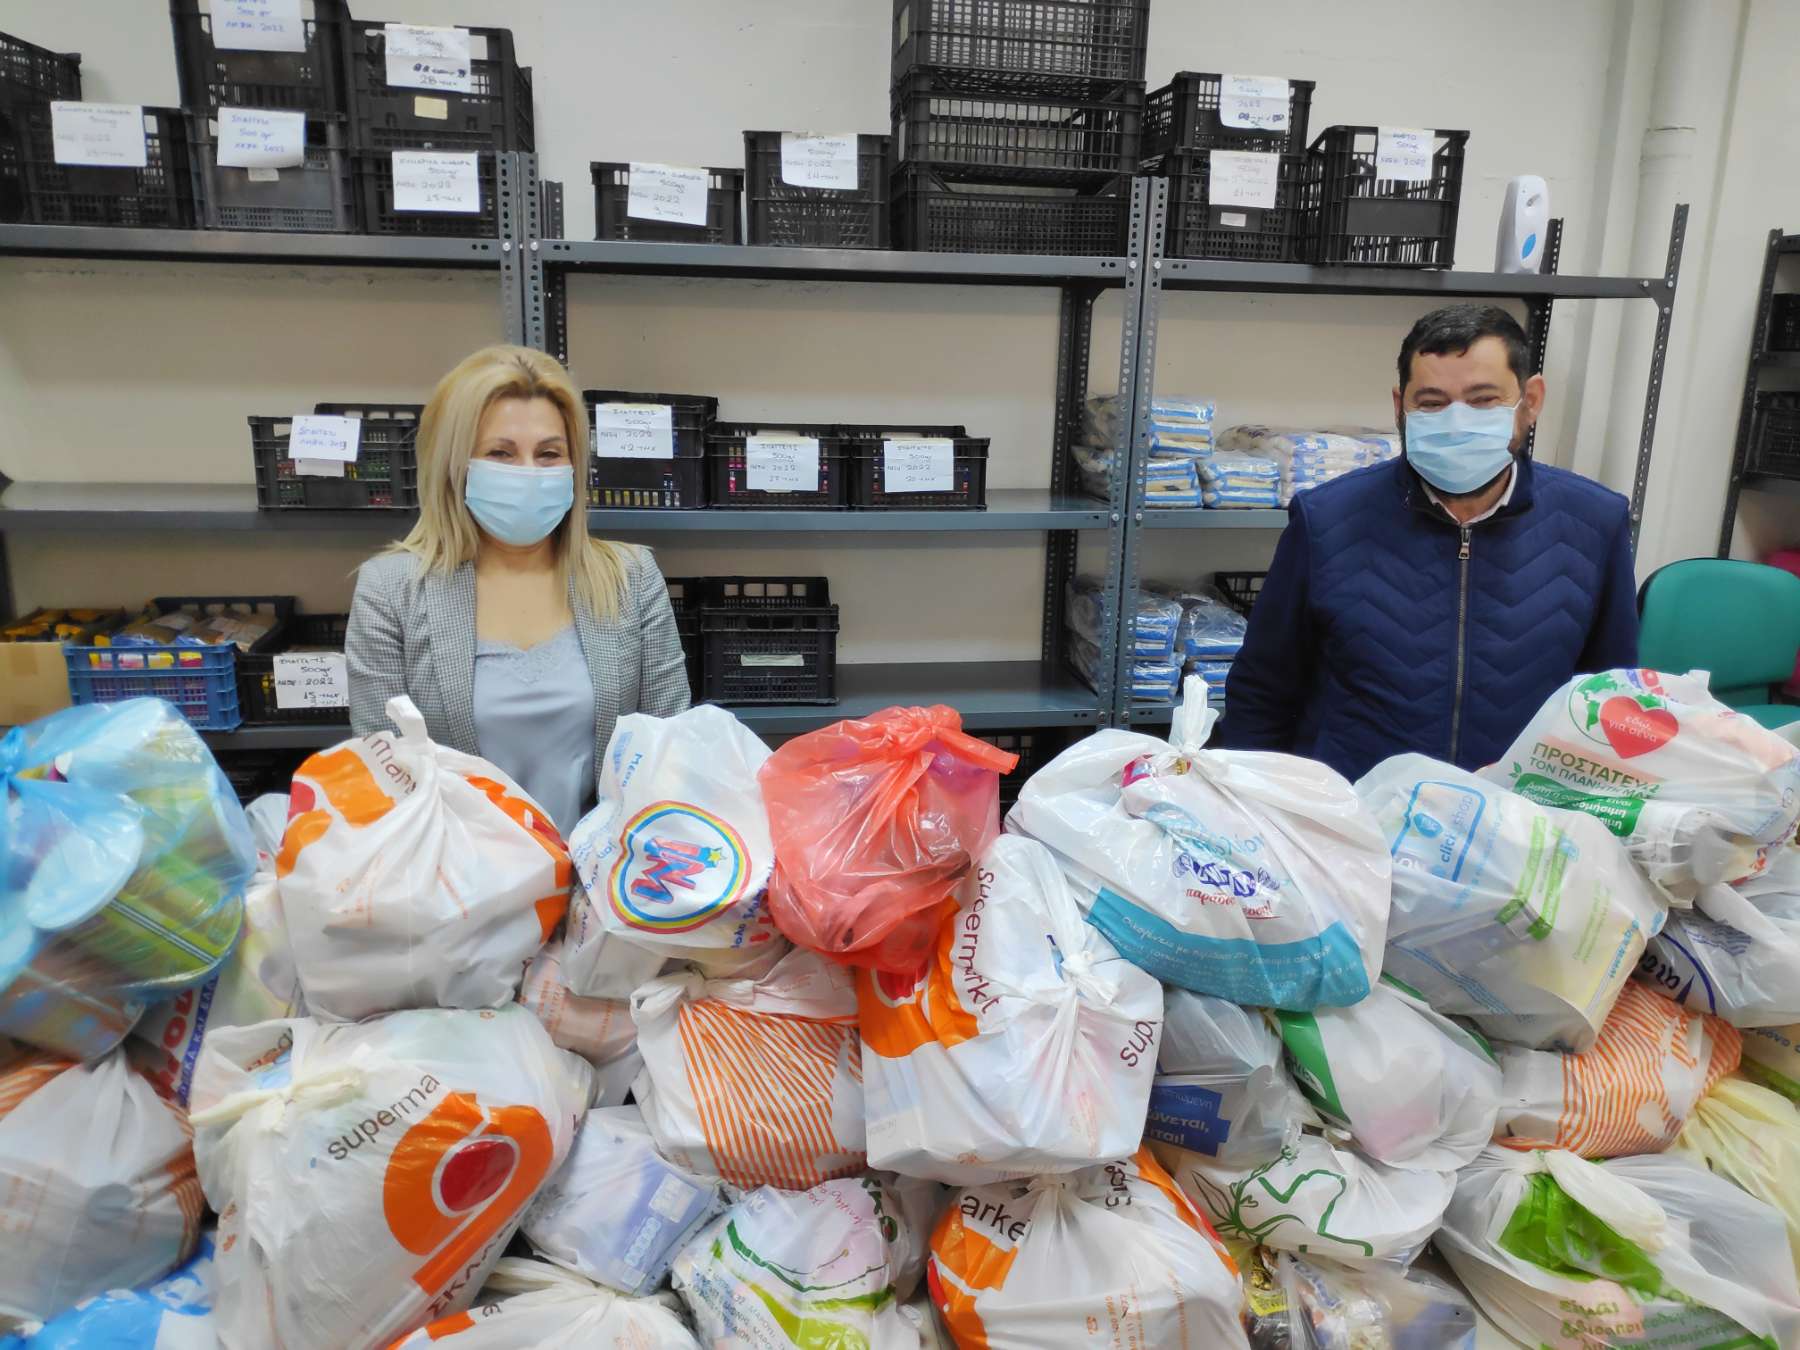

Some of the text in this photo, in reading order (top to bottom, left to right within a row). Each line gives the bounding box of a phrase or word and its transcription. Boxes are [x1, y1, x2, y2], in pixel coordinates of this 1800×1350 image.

[1529, 757, 1556, 774] ΤΟΝ
[328, 1074, 440, 1160] superma
[960, 1195, 1031, 1242] arke
